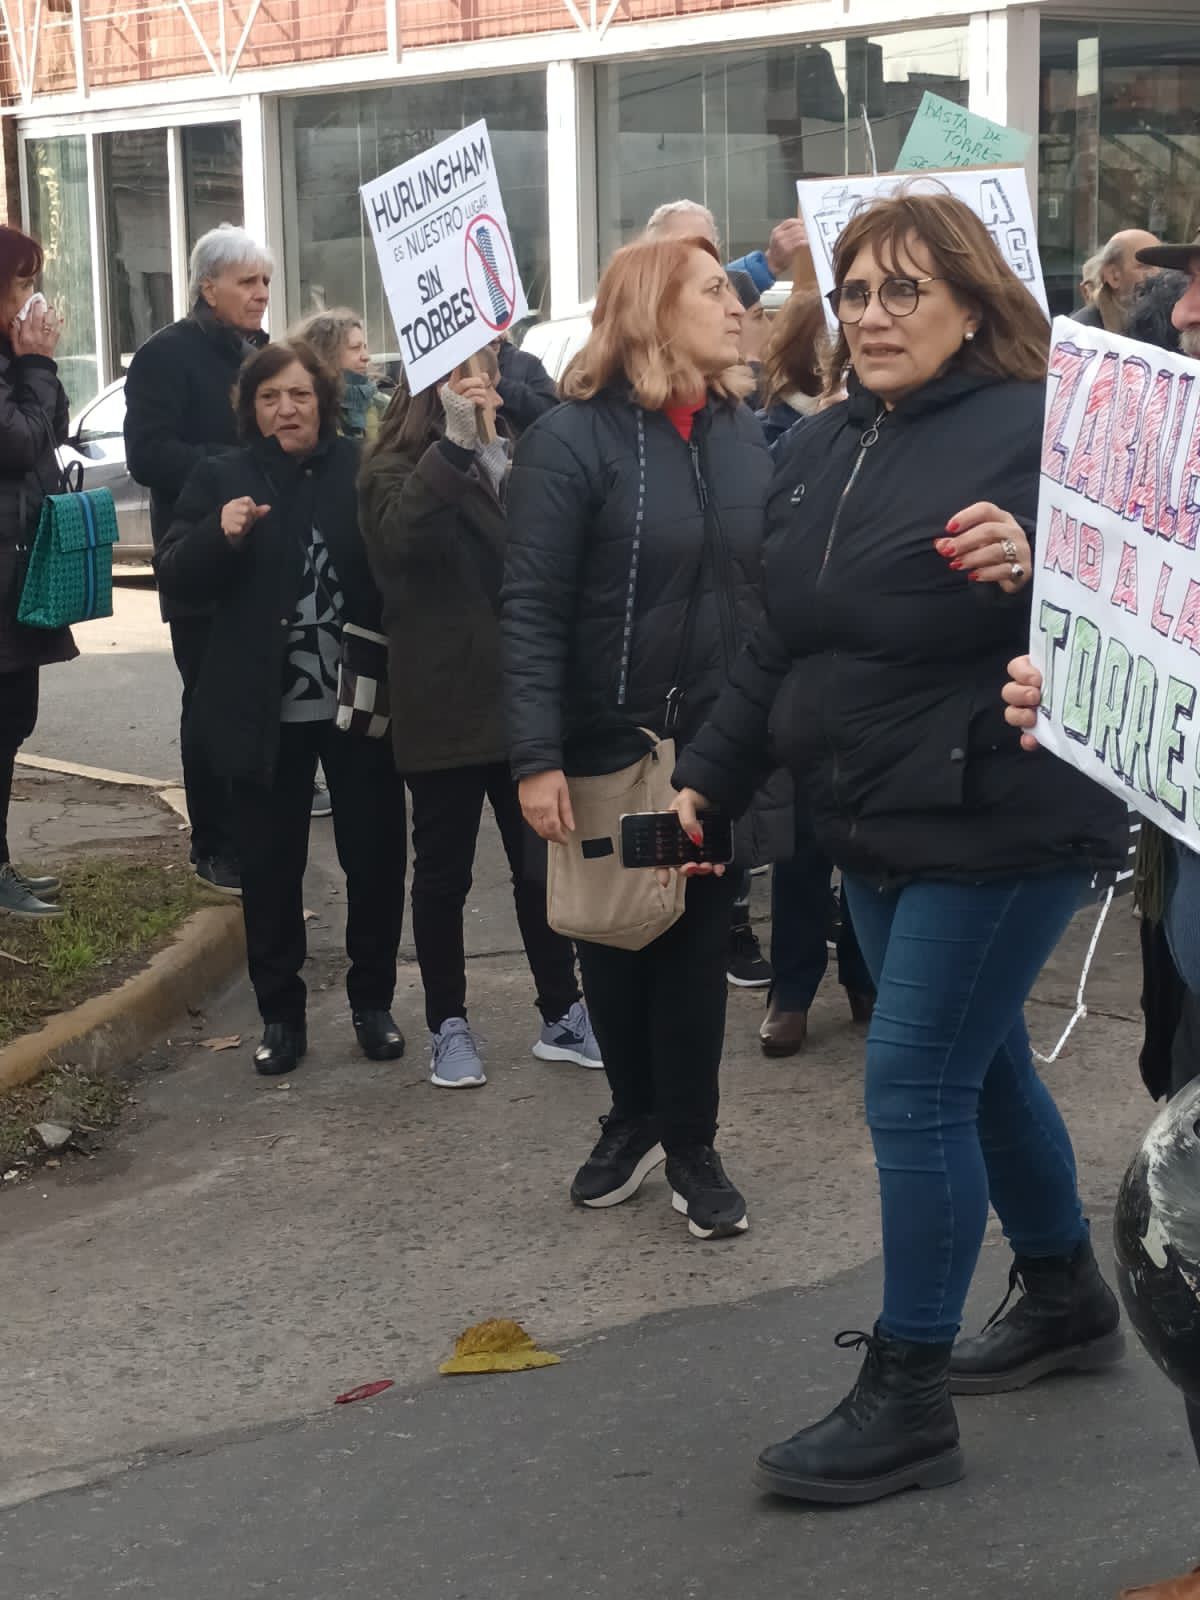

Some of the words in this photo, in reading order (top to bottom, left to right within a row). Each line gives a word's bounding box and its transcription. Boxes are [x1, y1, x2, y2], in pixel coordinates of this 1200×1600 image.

[371, 137, 490, 233] HURLINGHAM
[394, 244, 405, 263] ES
[405, 205, 464, 261] NUESTRO
[464, 194, 489, 220] LUGAR
[401, 286, 476, 363] TORRES
[418, 264, 444, 303] SIN
[1044, 505, 1104, 593] NO
[1111, 541, 1139, 616] A
[1039, 599, 1200, 831] TORRE
